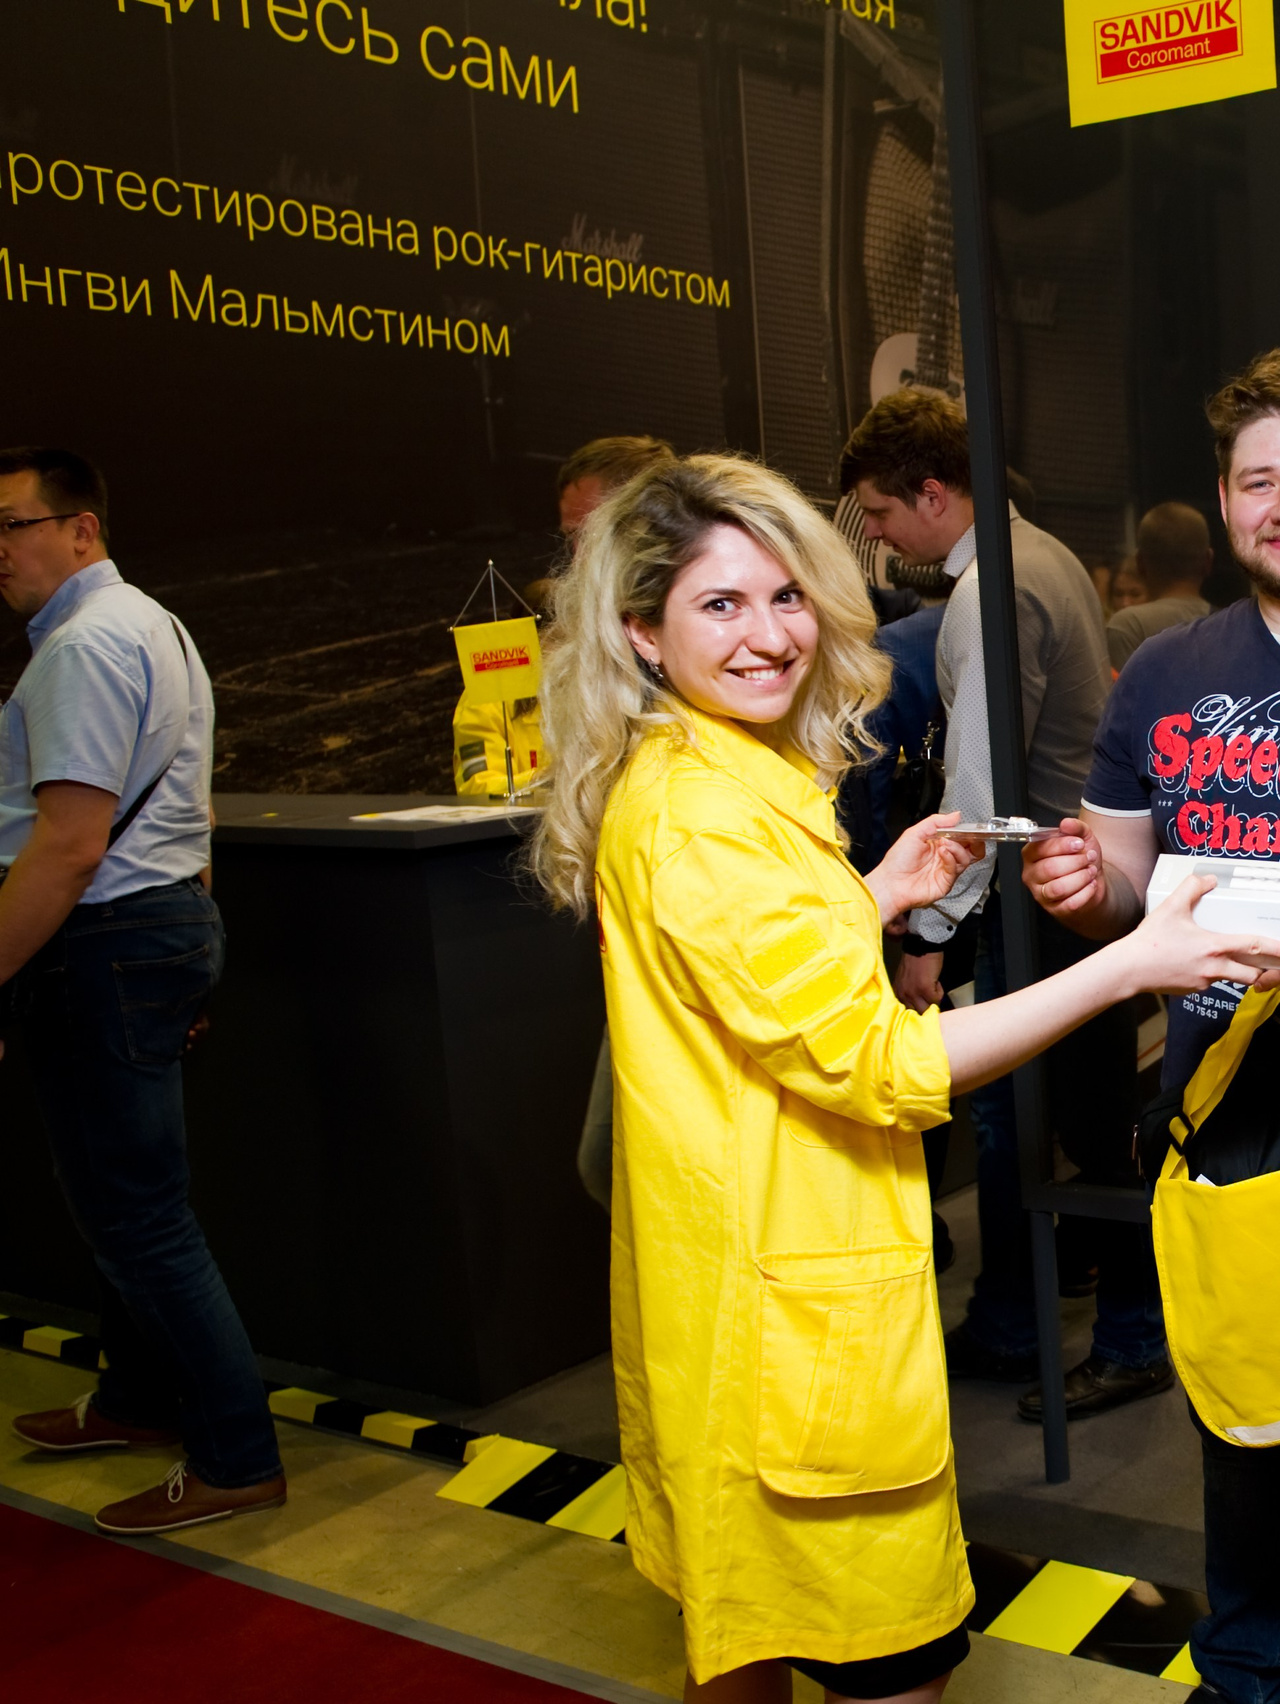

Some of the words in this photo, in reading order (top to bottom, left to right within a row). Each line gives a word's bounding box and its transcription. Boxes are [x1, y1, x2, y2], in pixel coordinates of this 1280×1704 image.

[1100, 0, 1237, 50] SANDVIK
[420, 26, 579, 114] сами
[1127, 37, 1211, 69] Coromant
[0, 151, 420, 258] ротестирована
[433, 225, 730, 309] рок-гитаристом
[169, 268, 511, 358] Мальмстином
[472, 646, 529, 664] SANDVIK
[1196, 1005, 1218, 1019] 7543
